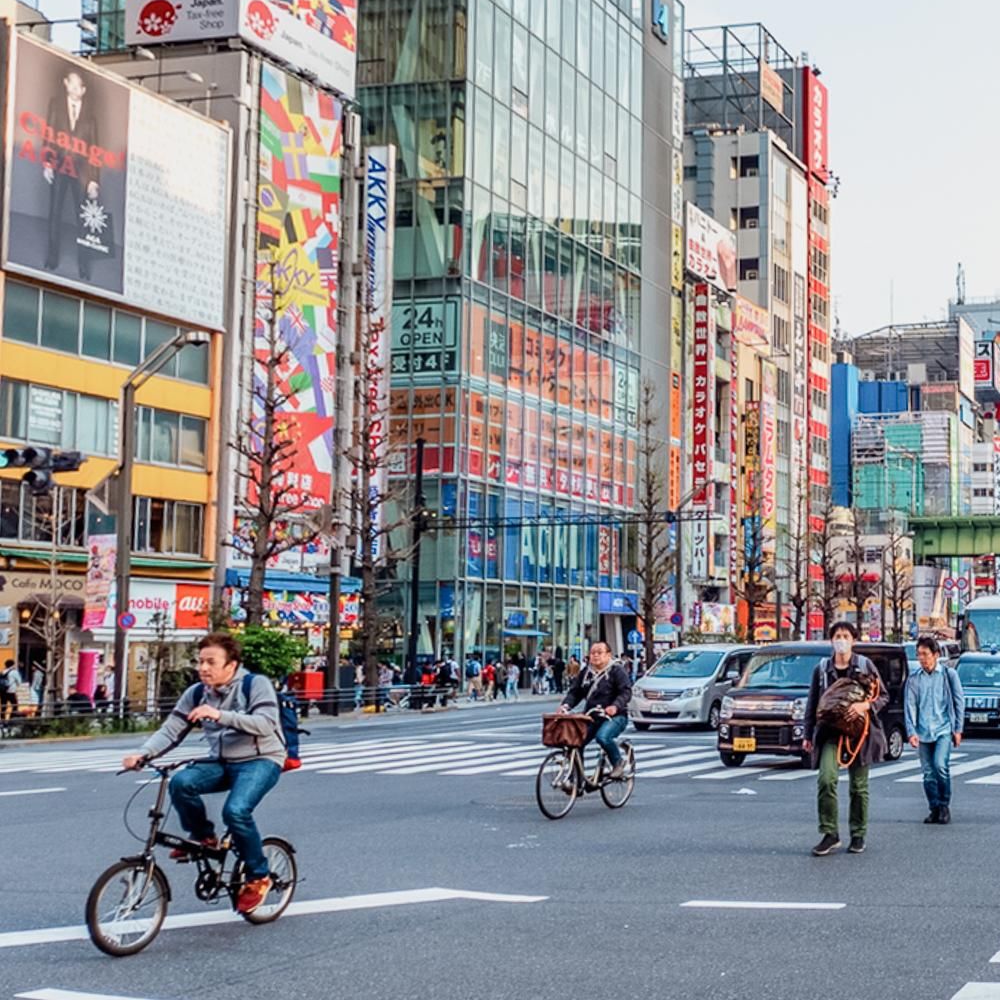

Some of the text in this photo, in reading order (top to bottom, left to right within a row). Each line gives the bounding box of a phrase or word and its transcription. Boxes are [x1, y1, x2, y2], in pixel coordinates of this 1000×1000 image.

[199, 19, 225, 30] Shop
[367, 155, 387, 232] AKKY
[400, 333, 443, 346] OPEN
[694, 510, 706, 572] ダーツバー
[179, 595, 206, 612] au
